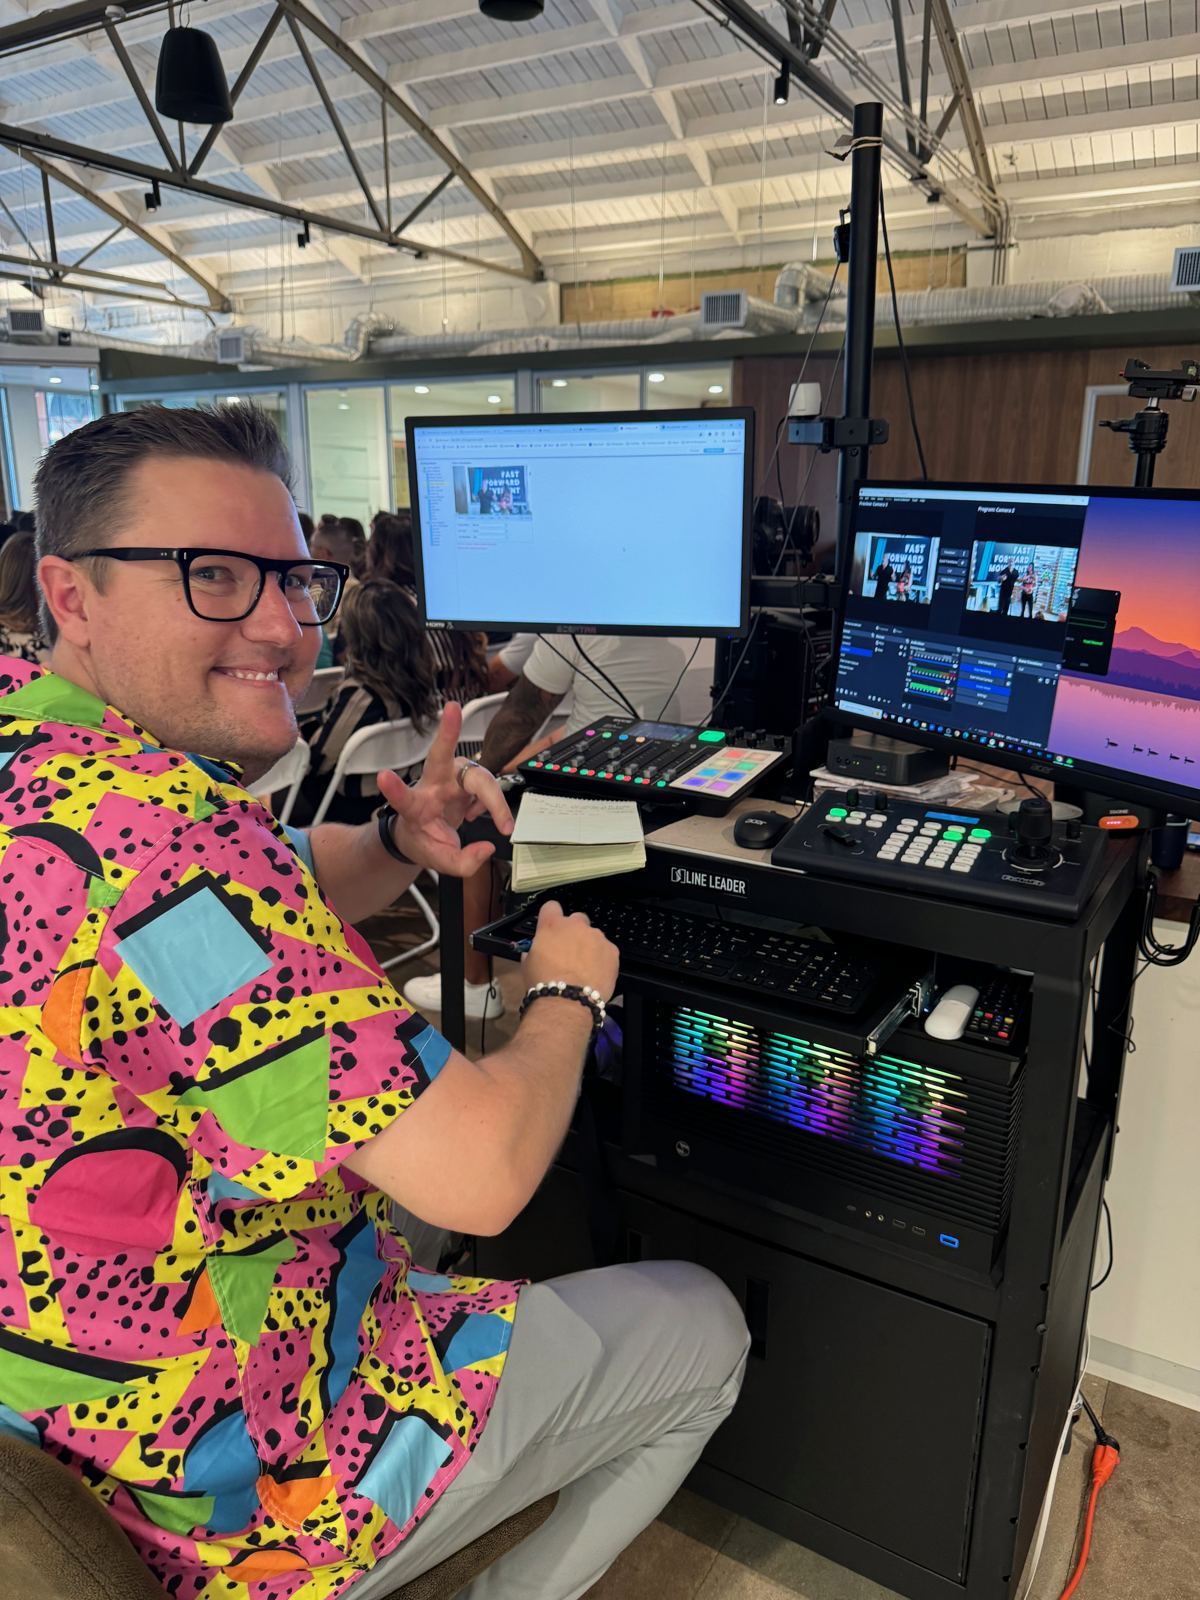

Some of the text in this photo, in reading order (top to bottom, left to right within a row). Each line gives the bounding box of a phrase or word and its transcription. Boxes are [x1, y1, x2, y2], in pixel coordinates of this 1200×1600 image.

[501, 470, 520, 478] FAST
[904, 543, 926, 554] FAST
[1013, 546, 1032, 555] FAST
[993, 554, 1030, 564] FORARD
[744, 818, 767, 826] acer
[686, 870, 746, 895] LINE LEADER
